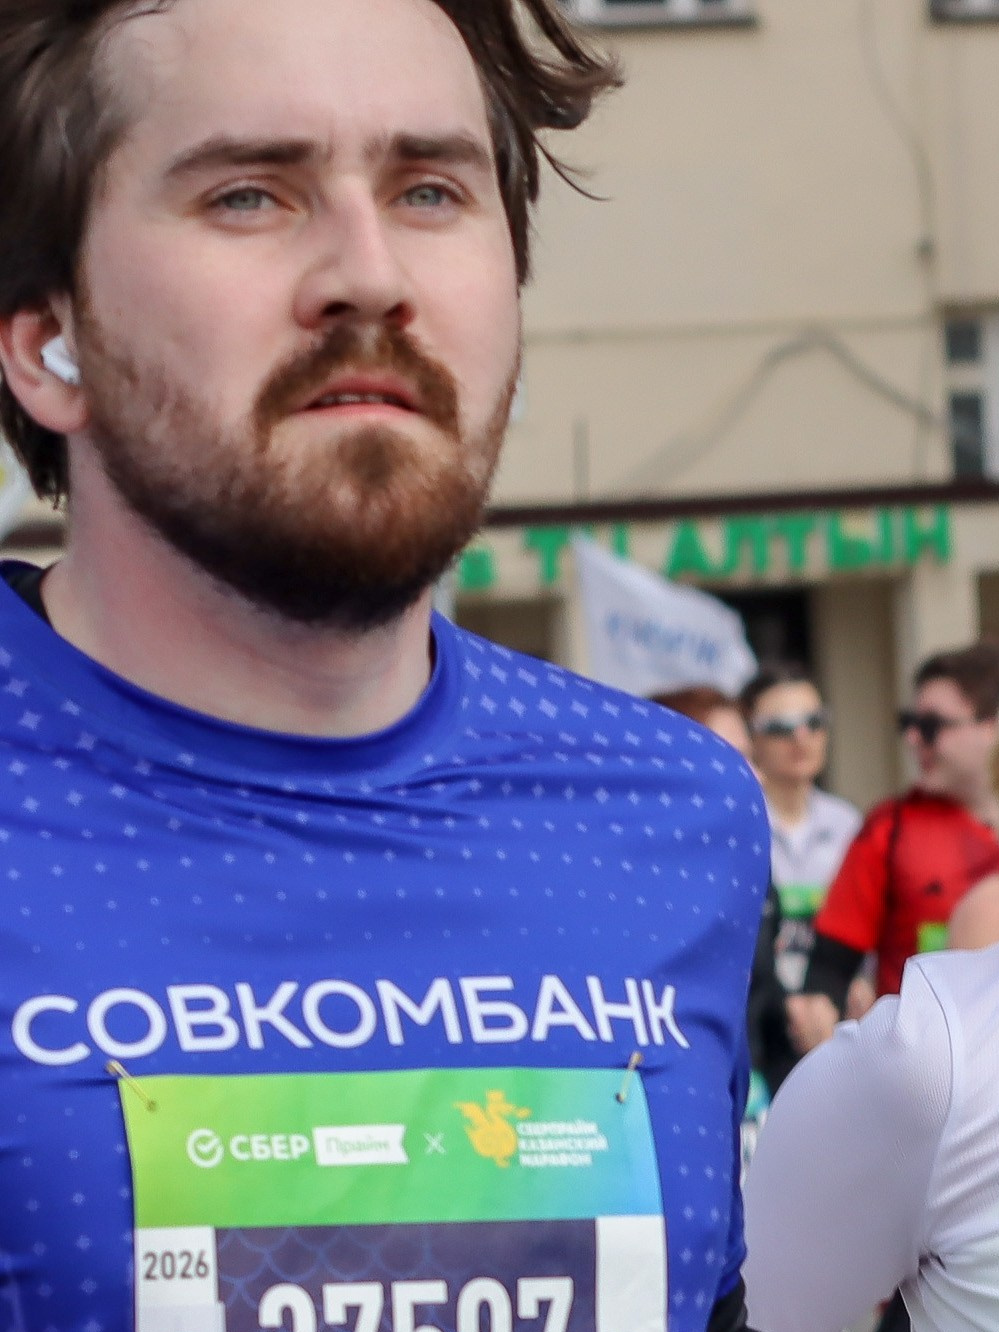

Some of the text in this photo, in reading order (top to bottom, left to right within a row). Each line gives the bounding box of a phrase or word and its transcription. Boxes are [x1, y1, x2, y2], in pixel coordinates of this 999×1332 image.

[667, 503, 951, 580] АЛТЫН
[11, 975, 690, 1066] СОВКОМБАНК
[229, 1133, 311, 1161] СБЕР
[143, 1251, 210, 1280] 2026
